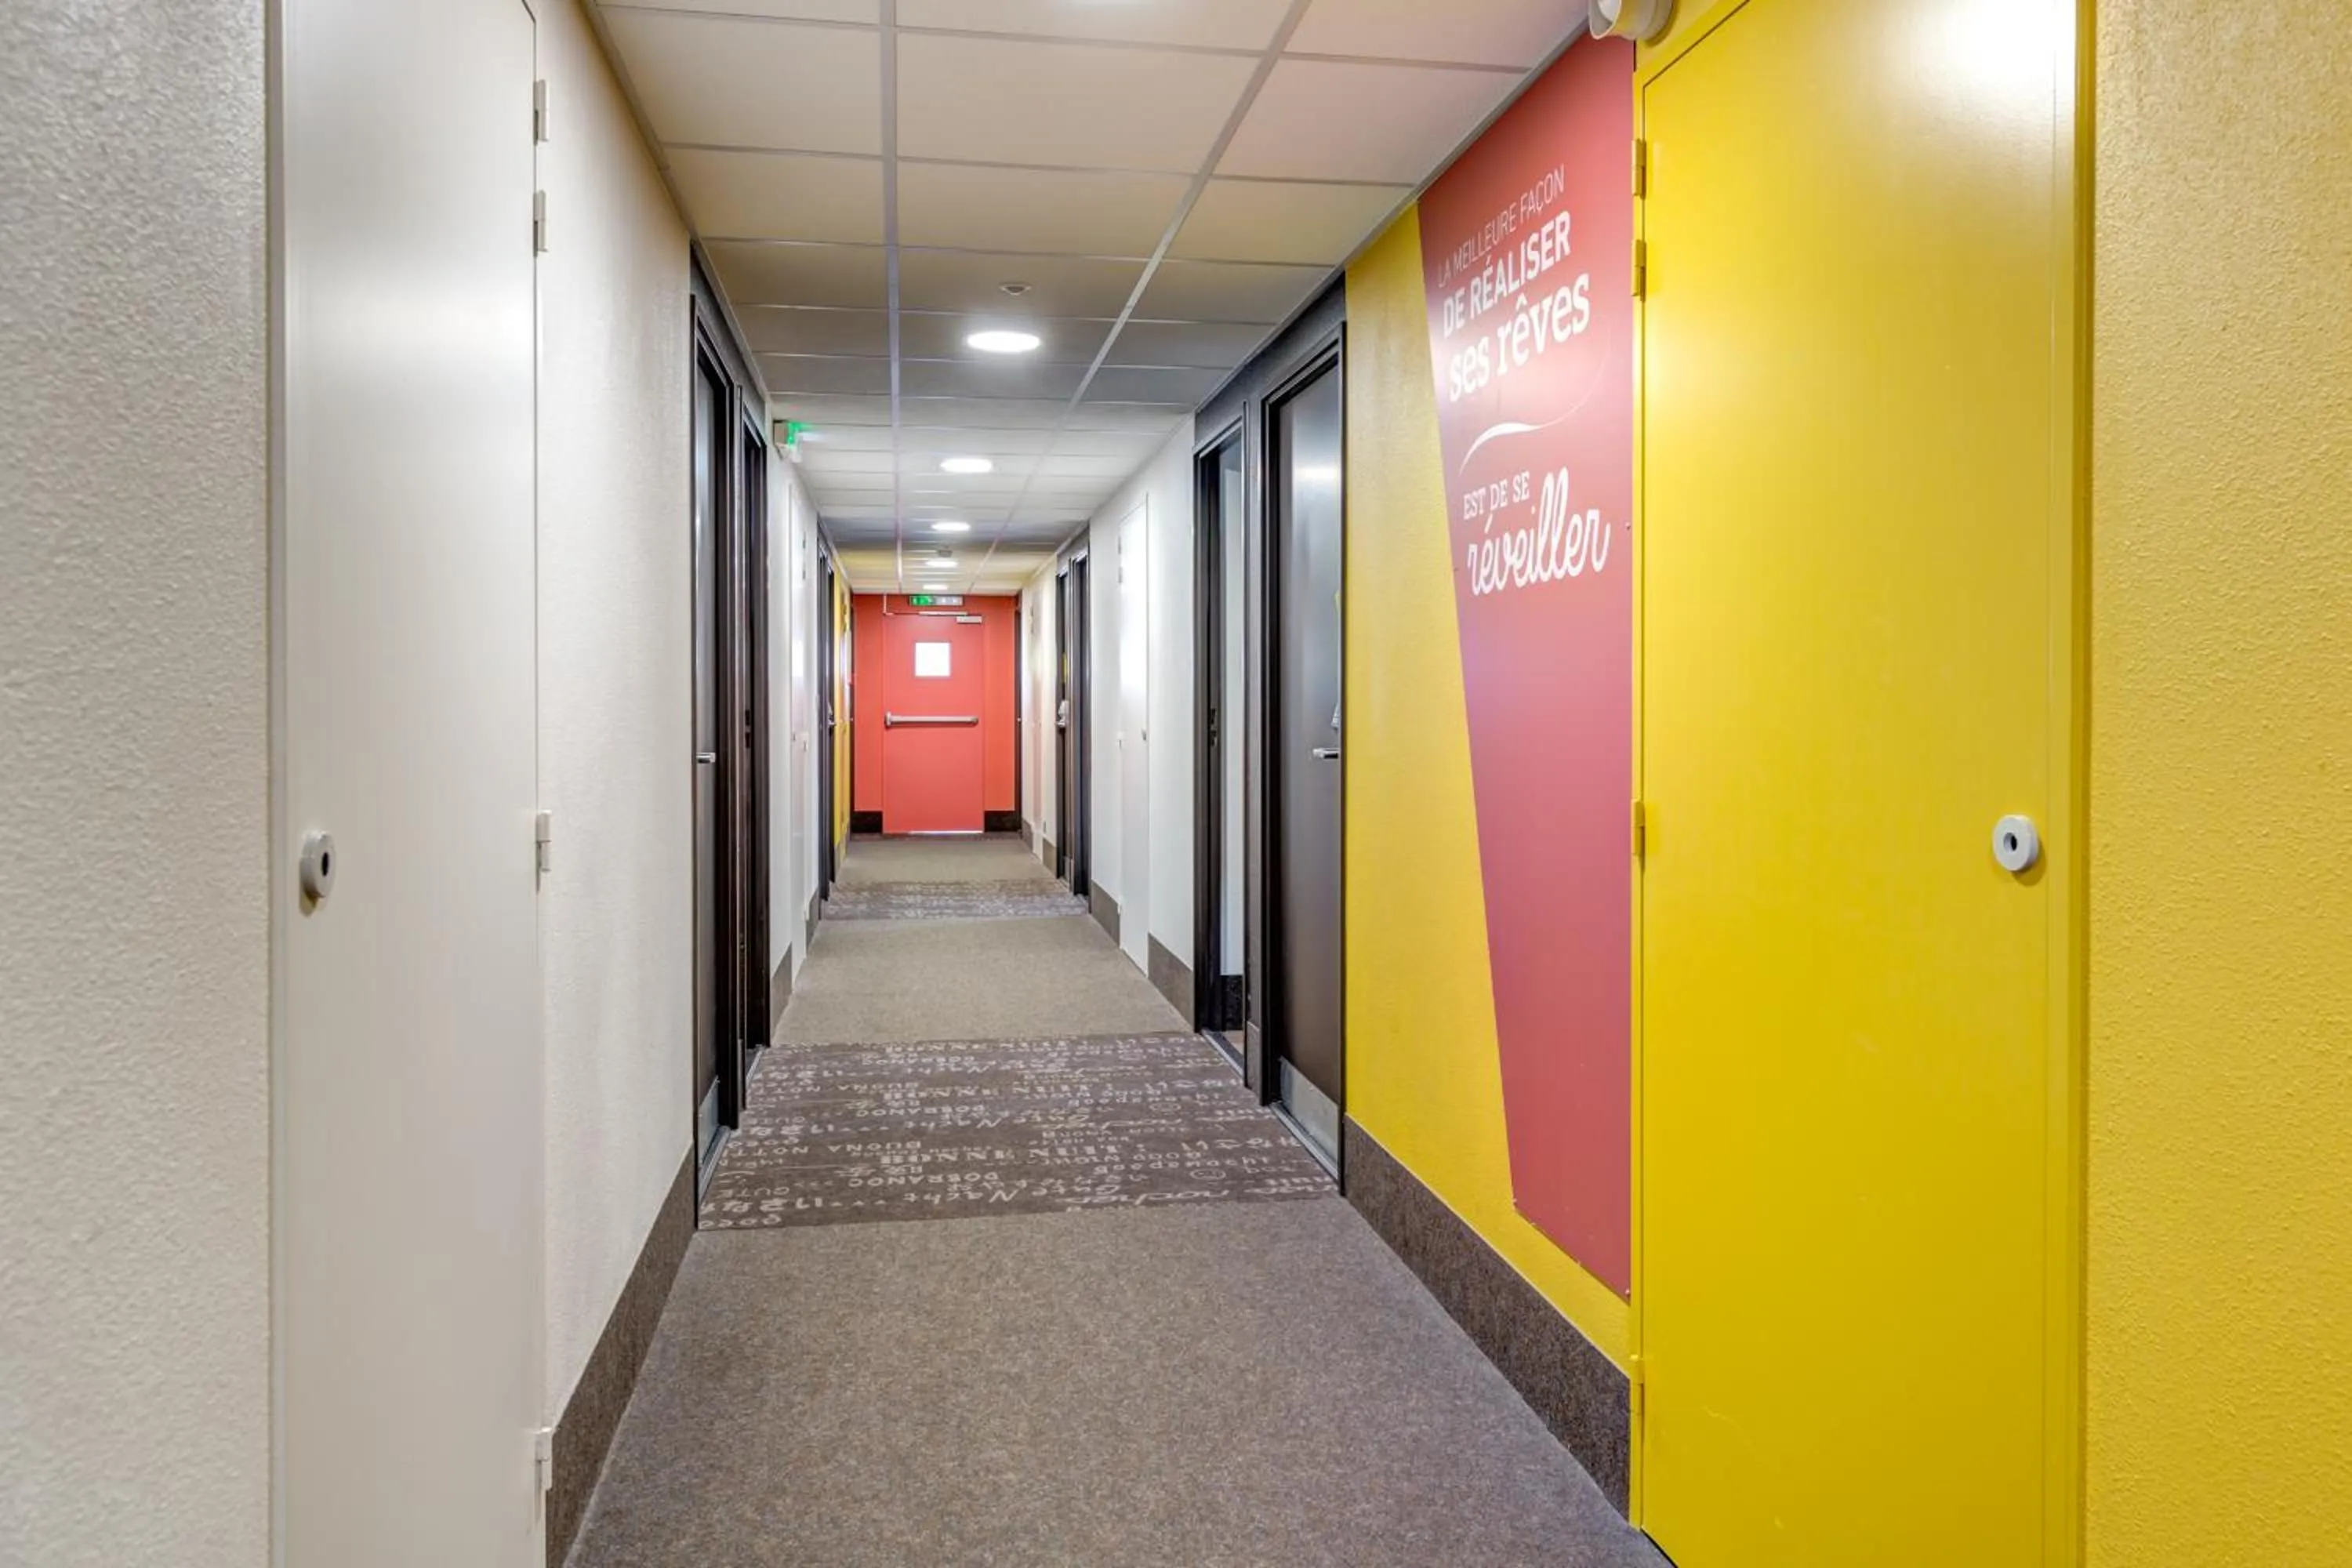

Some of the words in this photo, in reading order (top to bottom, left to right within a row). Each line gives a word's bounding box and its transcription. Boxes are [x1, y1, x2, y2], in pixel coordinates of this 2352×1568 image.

[1438, 262, 1450, 289] LA
[1452, 201, 1517, 270] MEILLEURE
[1519, 163, 1565, 223] FAÇON
[1443, 287, 1465, 339] DE
[1470, 210, 1571, 320] RÉALISER
[1450, 336, 1490, 402] ses
[1497, 273, 1590, 376] rêves
[1464, 487, 1486, 519] EST
[1490, 479, 1508, 510] DE
[1512, 470, 1530, 503] SE
[1467, 466, 1611, 595] réveiller
